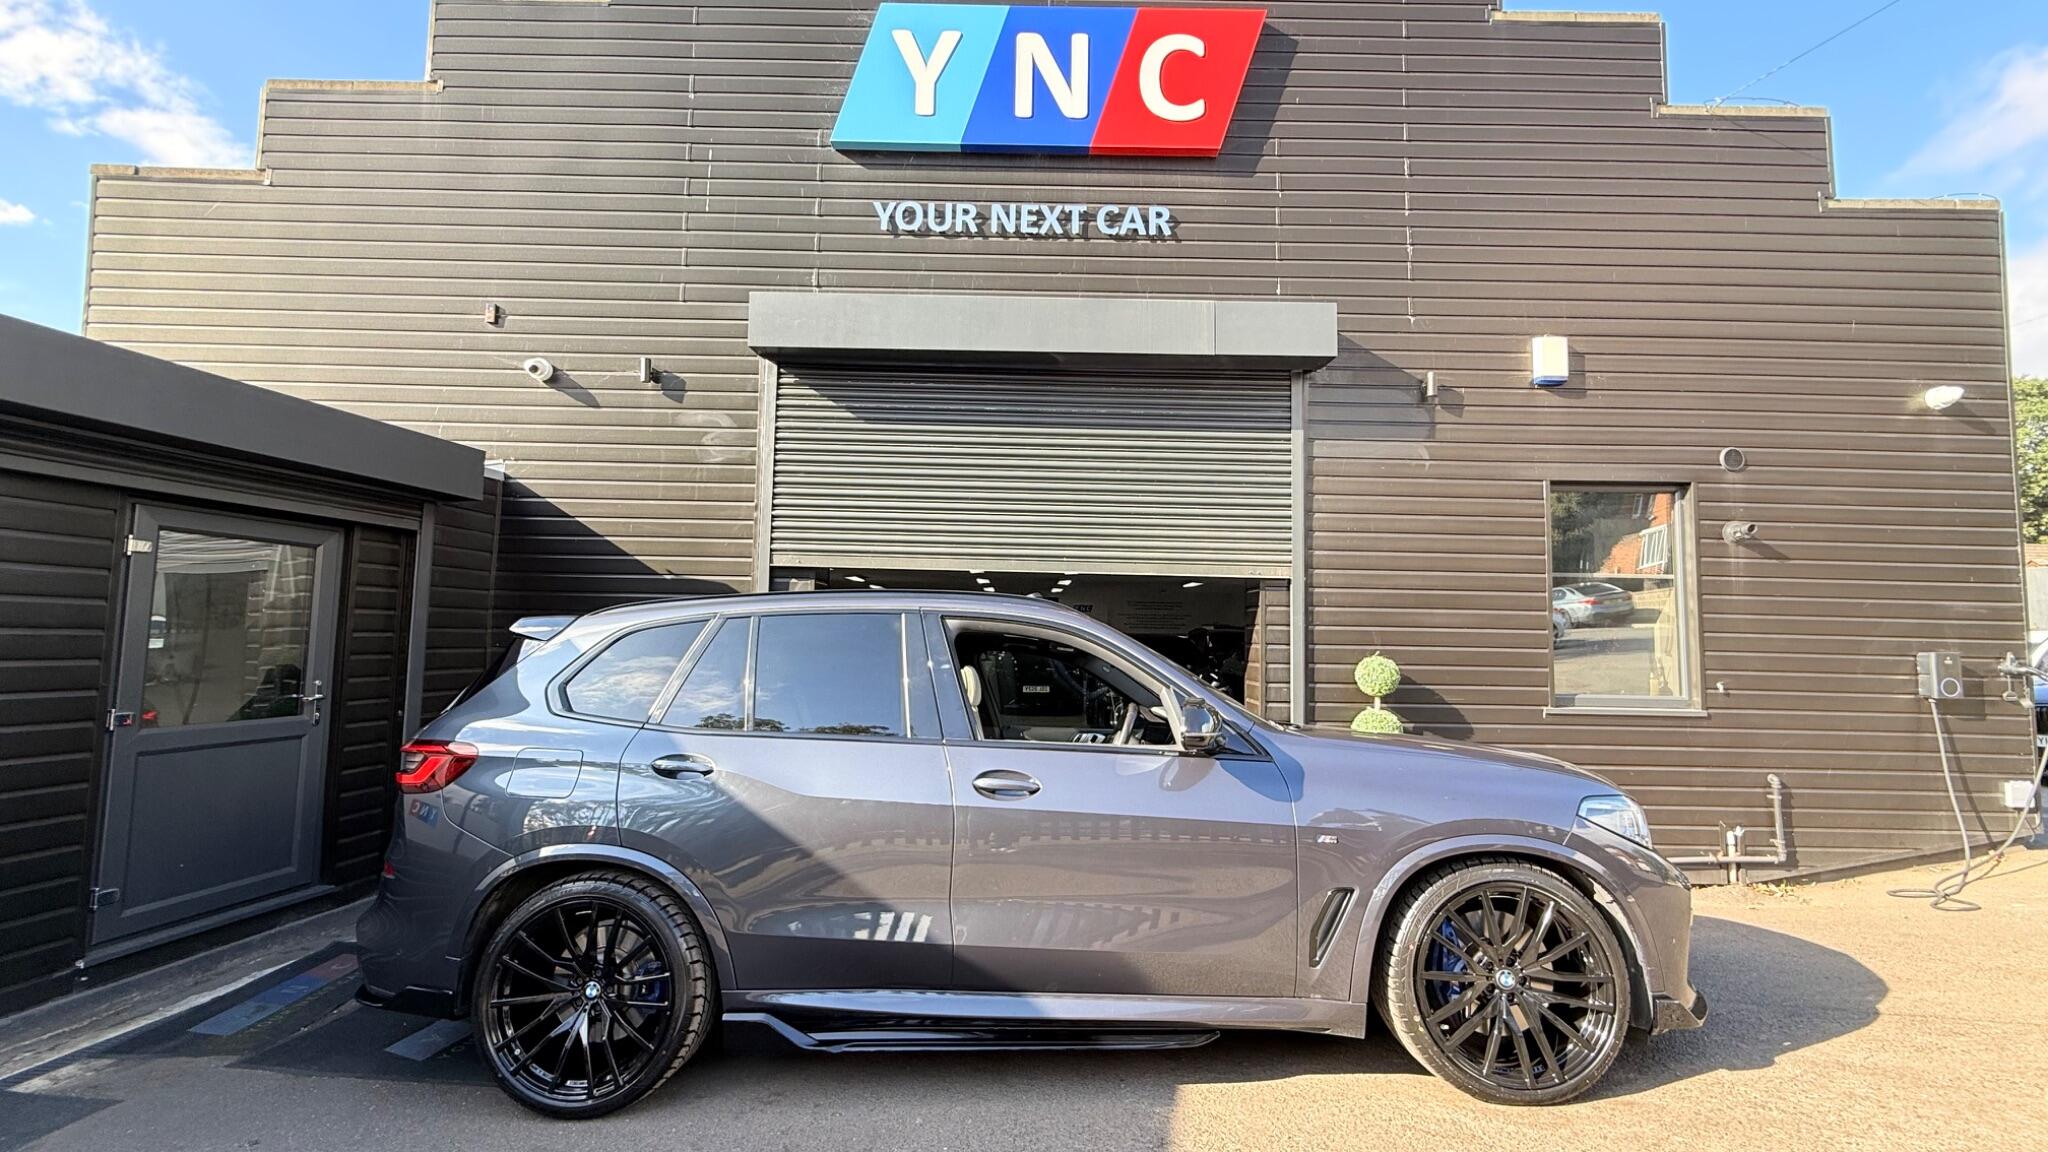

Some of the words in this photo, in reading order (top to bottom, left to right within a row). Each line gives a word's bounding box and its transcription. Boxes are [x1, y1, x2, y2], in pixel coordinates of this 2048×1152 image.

[891, 29, 1206, 122] YNC
[873, 201, 979, 234] YOUR
[990, 203, 1087, 236] NEXT
[1097, 205, 1172, 237] CAR
